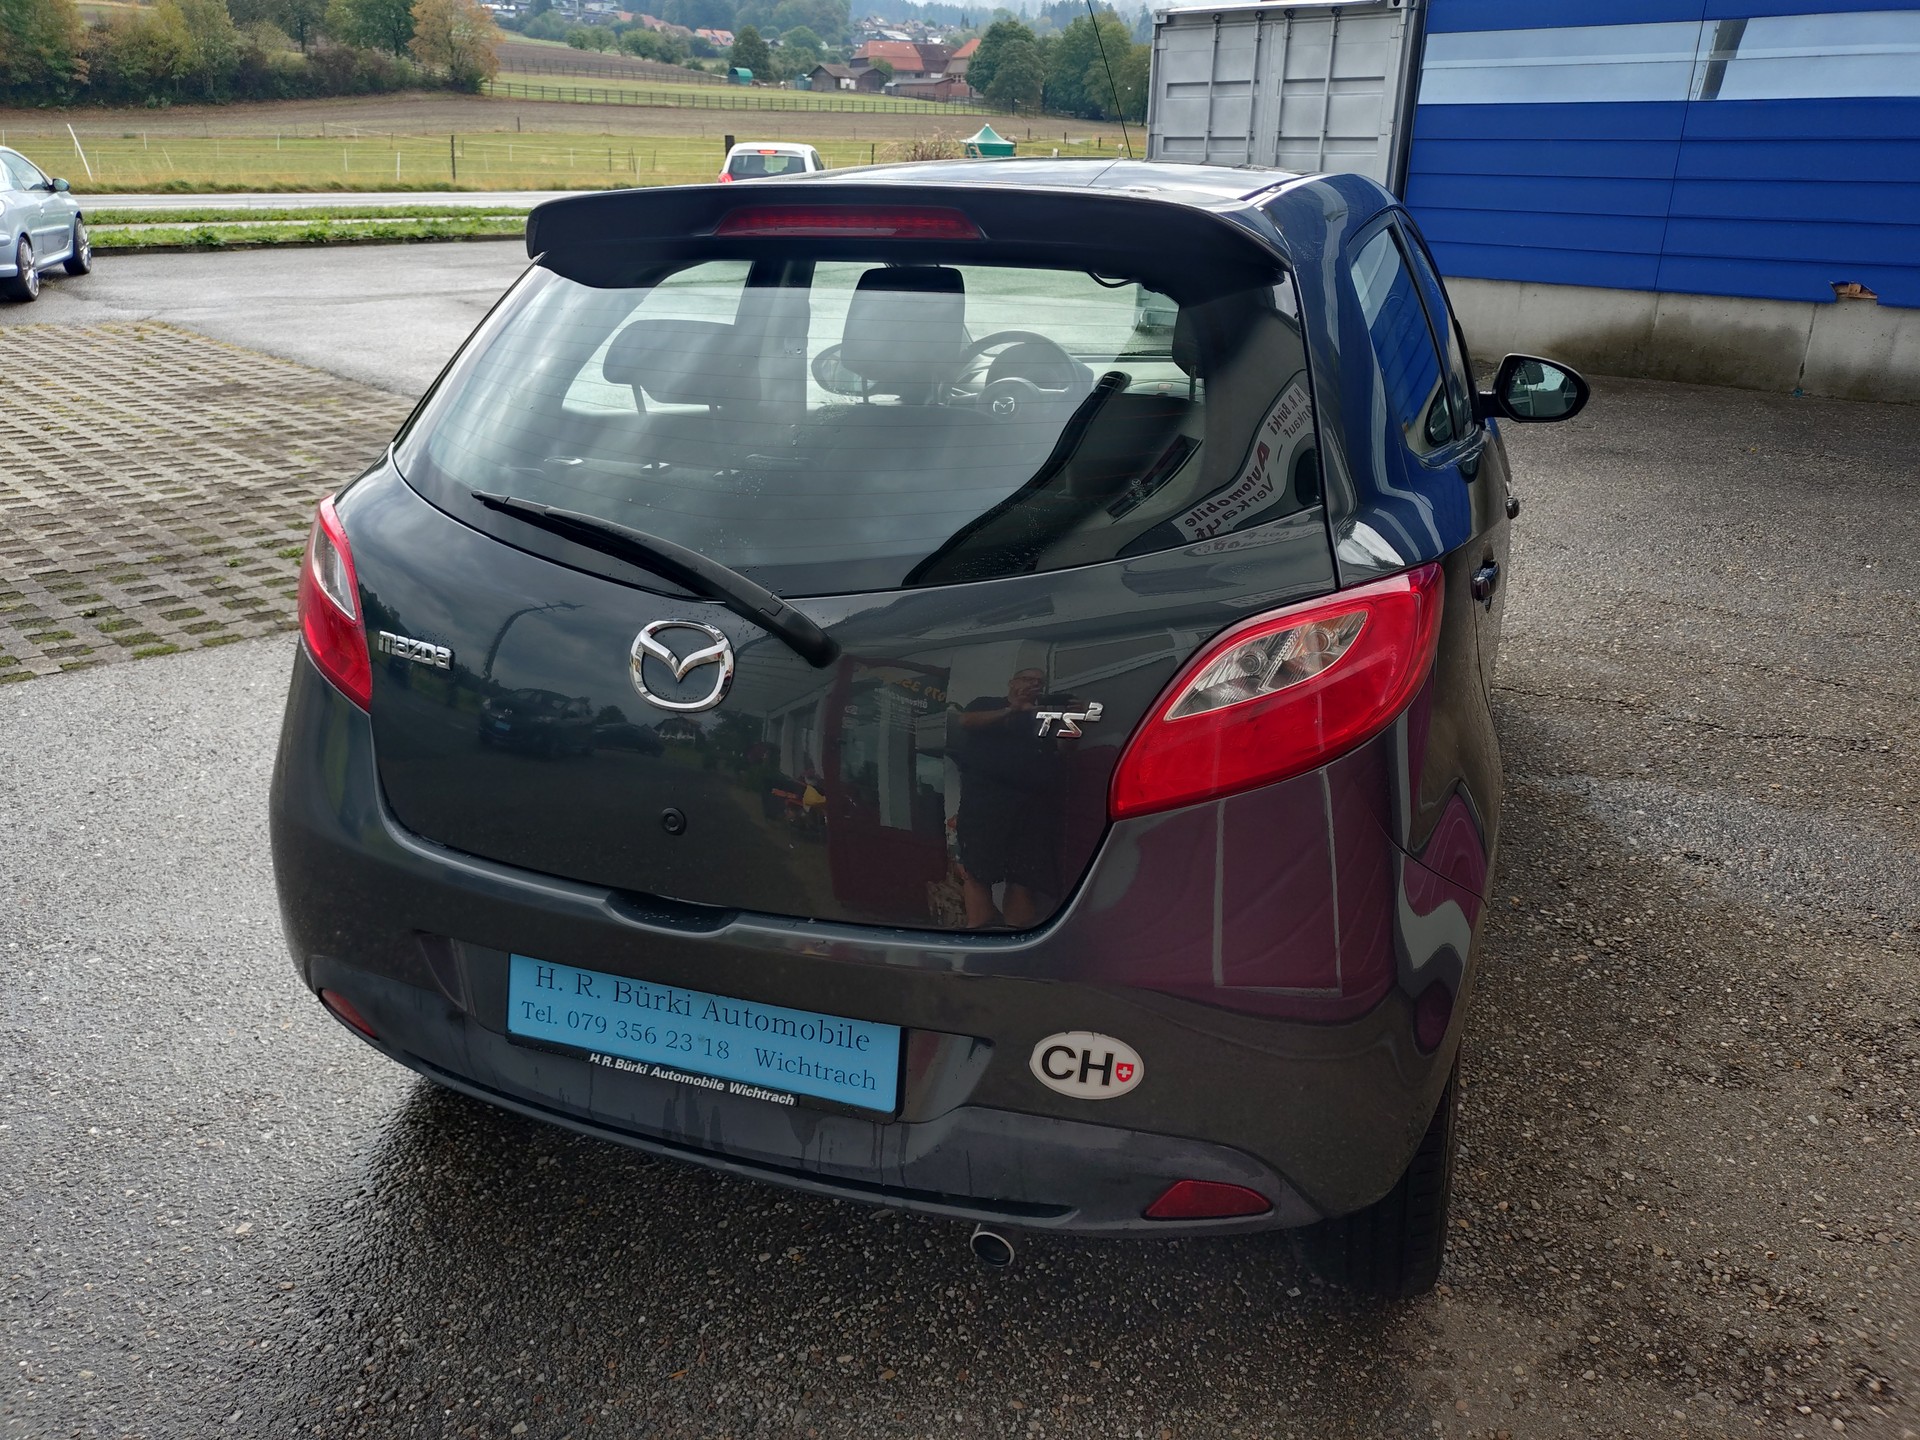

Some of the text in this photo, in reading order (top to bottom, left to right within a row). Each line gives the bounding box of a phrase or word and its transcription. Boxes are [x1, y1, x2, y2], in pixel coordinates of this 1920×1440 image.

[535, 965, 870, 1052] H. R. Bürki Automobile
[521, 1000, 877, 1091] Tel. 079 356 23 18 Wichtrach
[1041, 1045, 1114, 1086] CH
[650, 1066, 725, 1091] Automobile
[729, 1081, 795, 1106] Wichtrach
